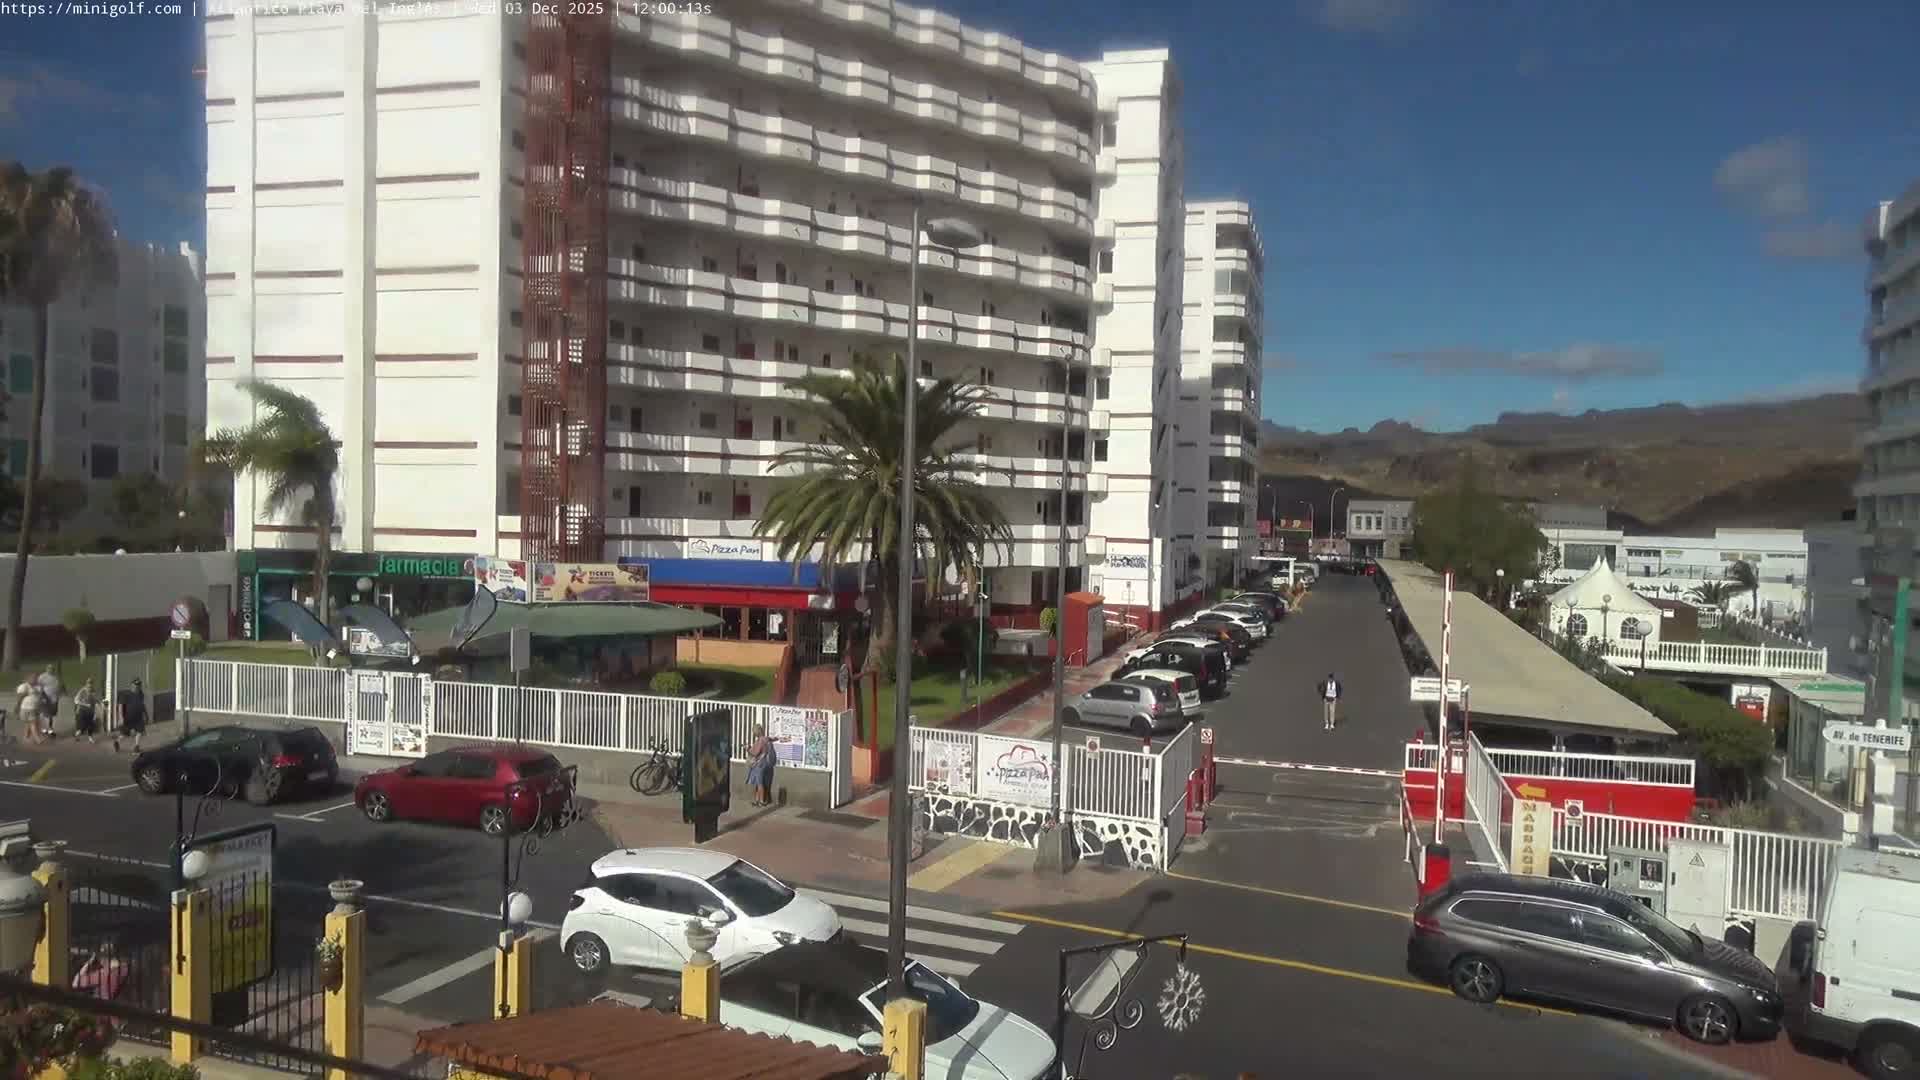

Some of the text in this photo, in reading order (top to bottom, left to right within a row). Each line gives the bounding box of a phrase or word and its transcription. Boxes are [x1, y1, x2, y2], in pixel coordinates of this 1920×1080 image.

[711, 544, 760, 555] Pizza Pan
[1849, 732, 1860, 742] de
[1862, 733, 1905, 745] TENERIFE
